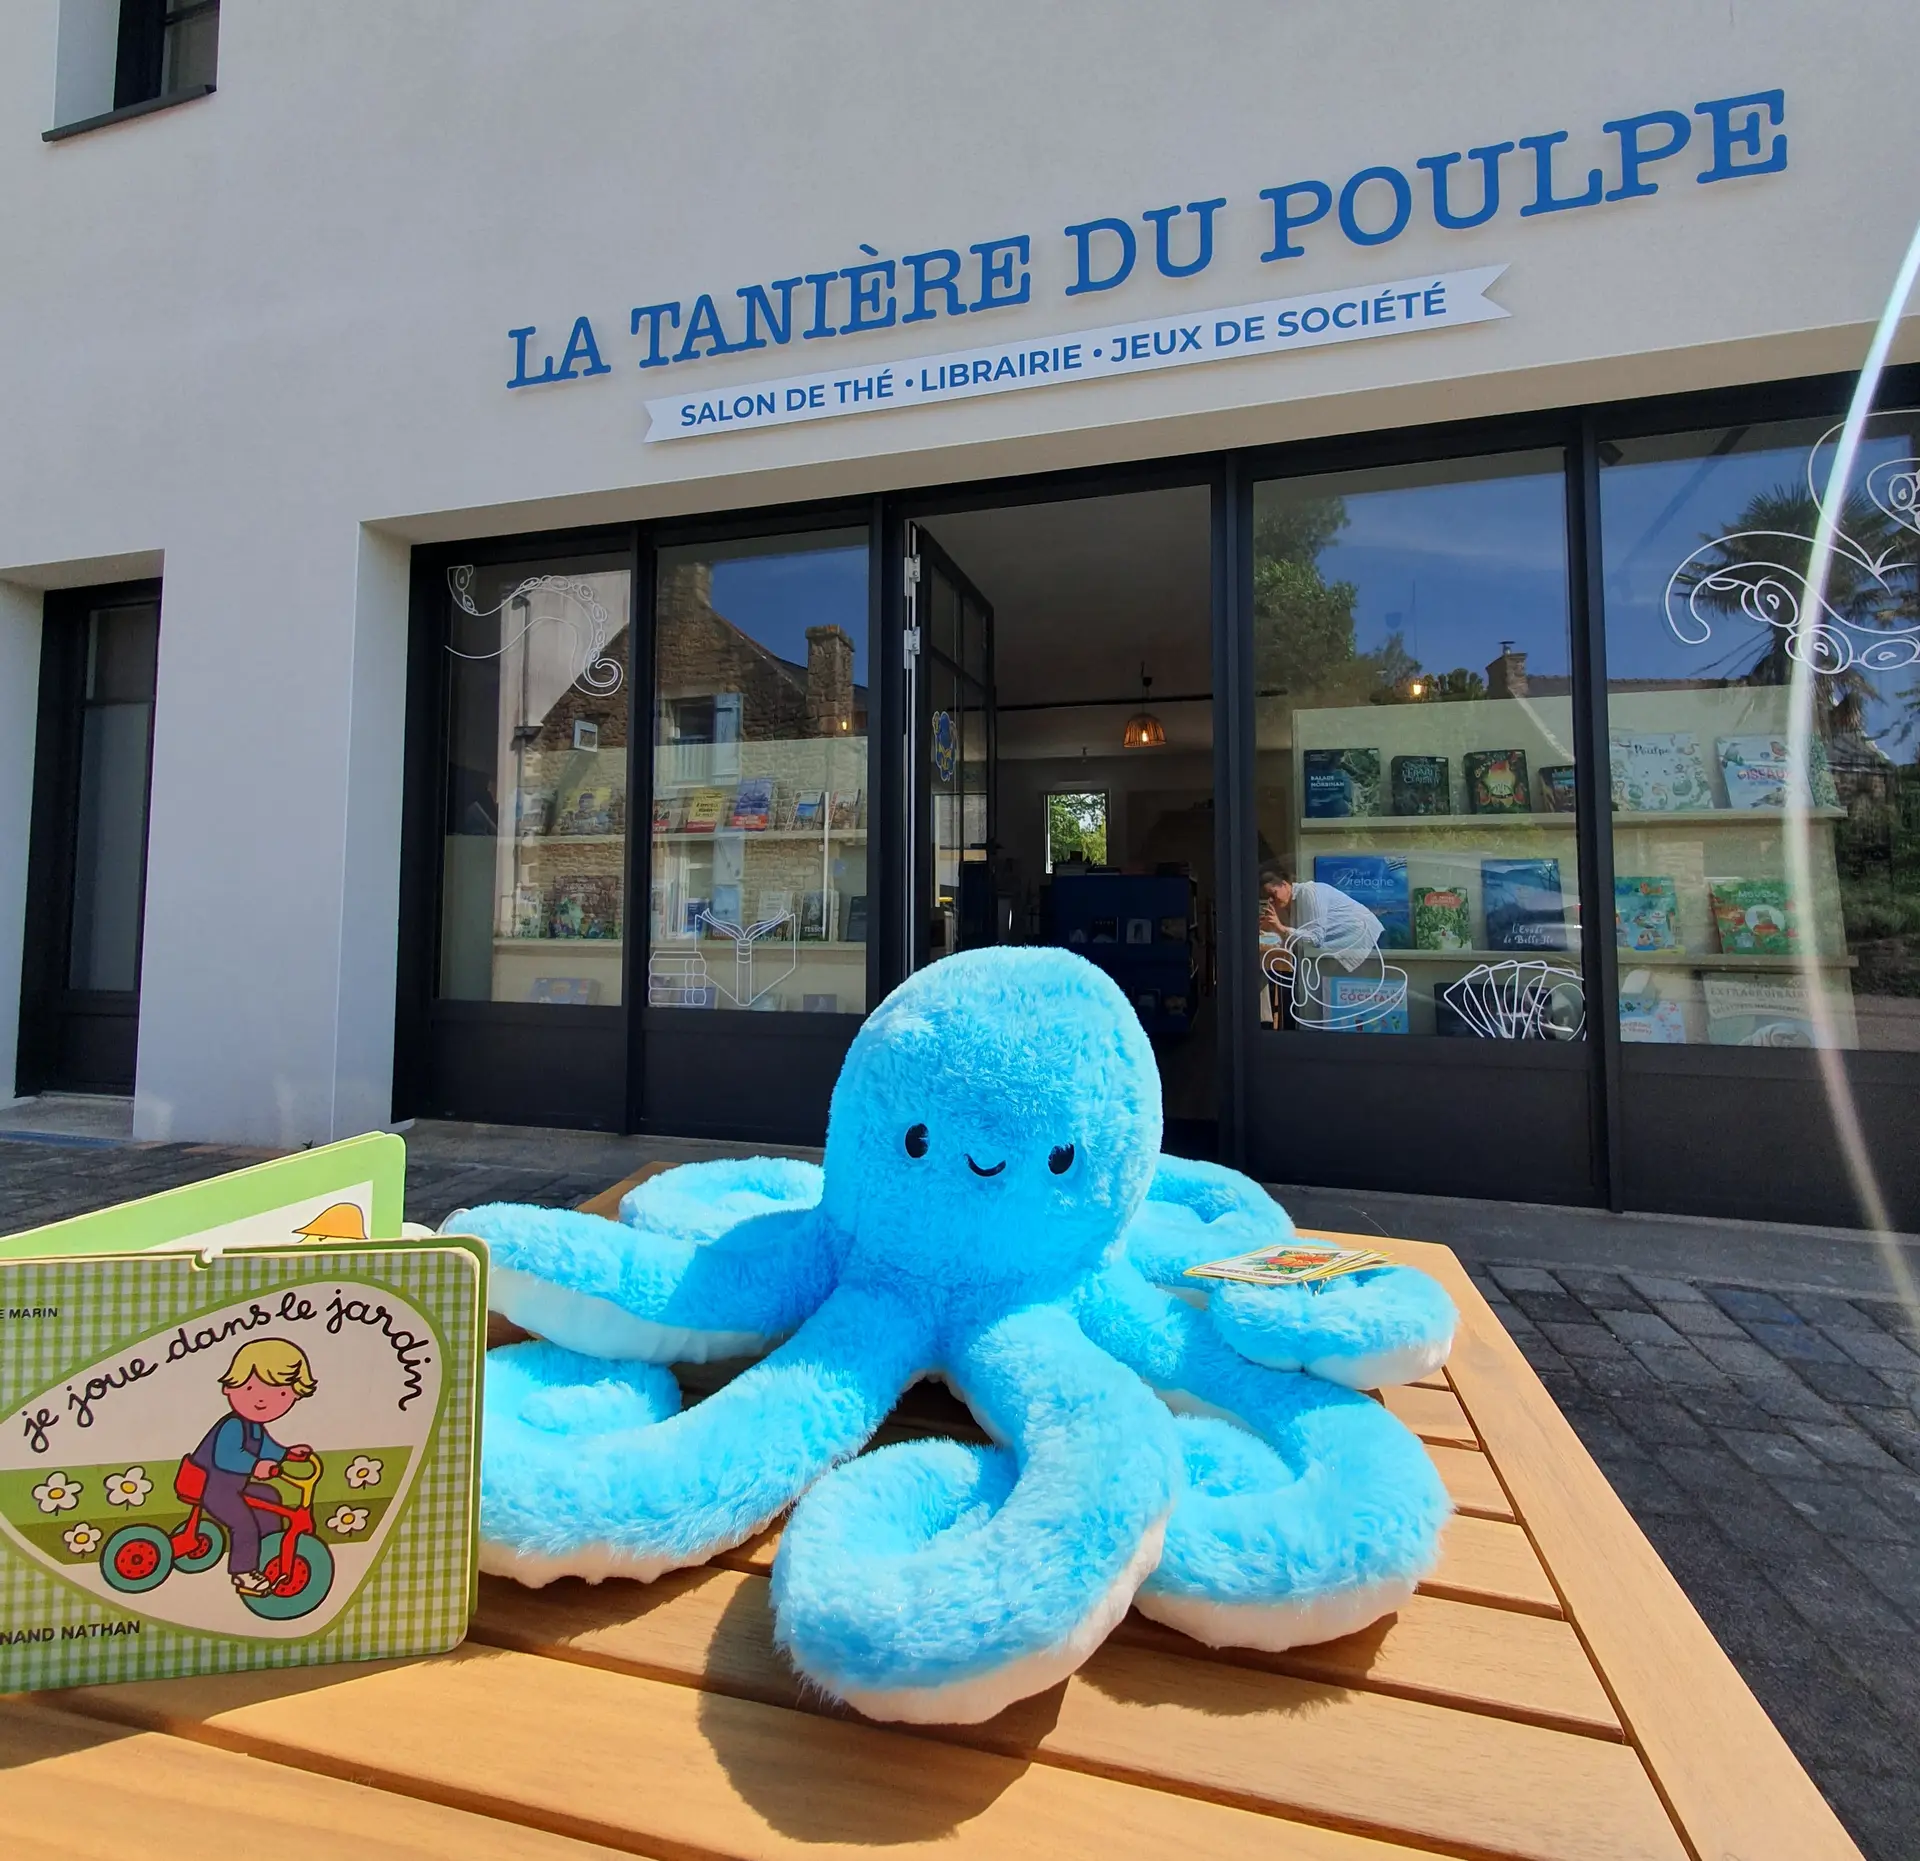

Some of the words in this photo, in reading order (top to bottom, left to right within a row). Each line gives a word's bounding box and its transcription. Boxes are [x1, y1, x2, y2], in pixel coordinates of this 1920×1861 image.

[506, 316, 611, 389] LA
[630, 243, 1031, 369] TANIÈRE
[1063, 198, 1226, 297] DU
[1259, 88, 1788, 263] POULPE
[681, 392, 776, 427] SALON
[785, 385, 825, 412] DE
[833, 368, 893, 404] THÉ
[921, 345, 1082, 393] LIBRAIRIE
[1110, 326, 1202, 363] JEUX
[1214, 316, 1265, 347] DE
[1277, 281, 1447, 337] SOCIÉTÉ
[1332, 868, 1395, 889] Bretagne
[9, 1307, 58, 1319] MARIN
[22, 1408, 60, 1453] je
[67, 1359, 159, 1428] joue
[165, 1304, 272, 1364] dans
[275, 1291, 318, 1322] le
[325, 1288, 432, 1412] jardin
[61, 1620, 140, 1640] NATHAN
